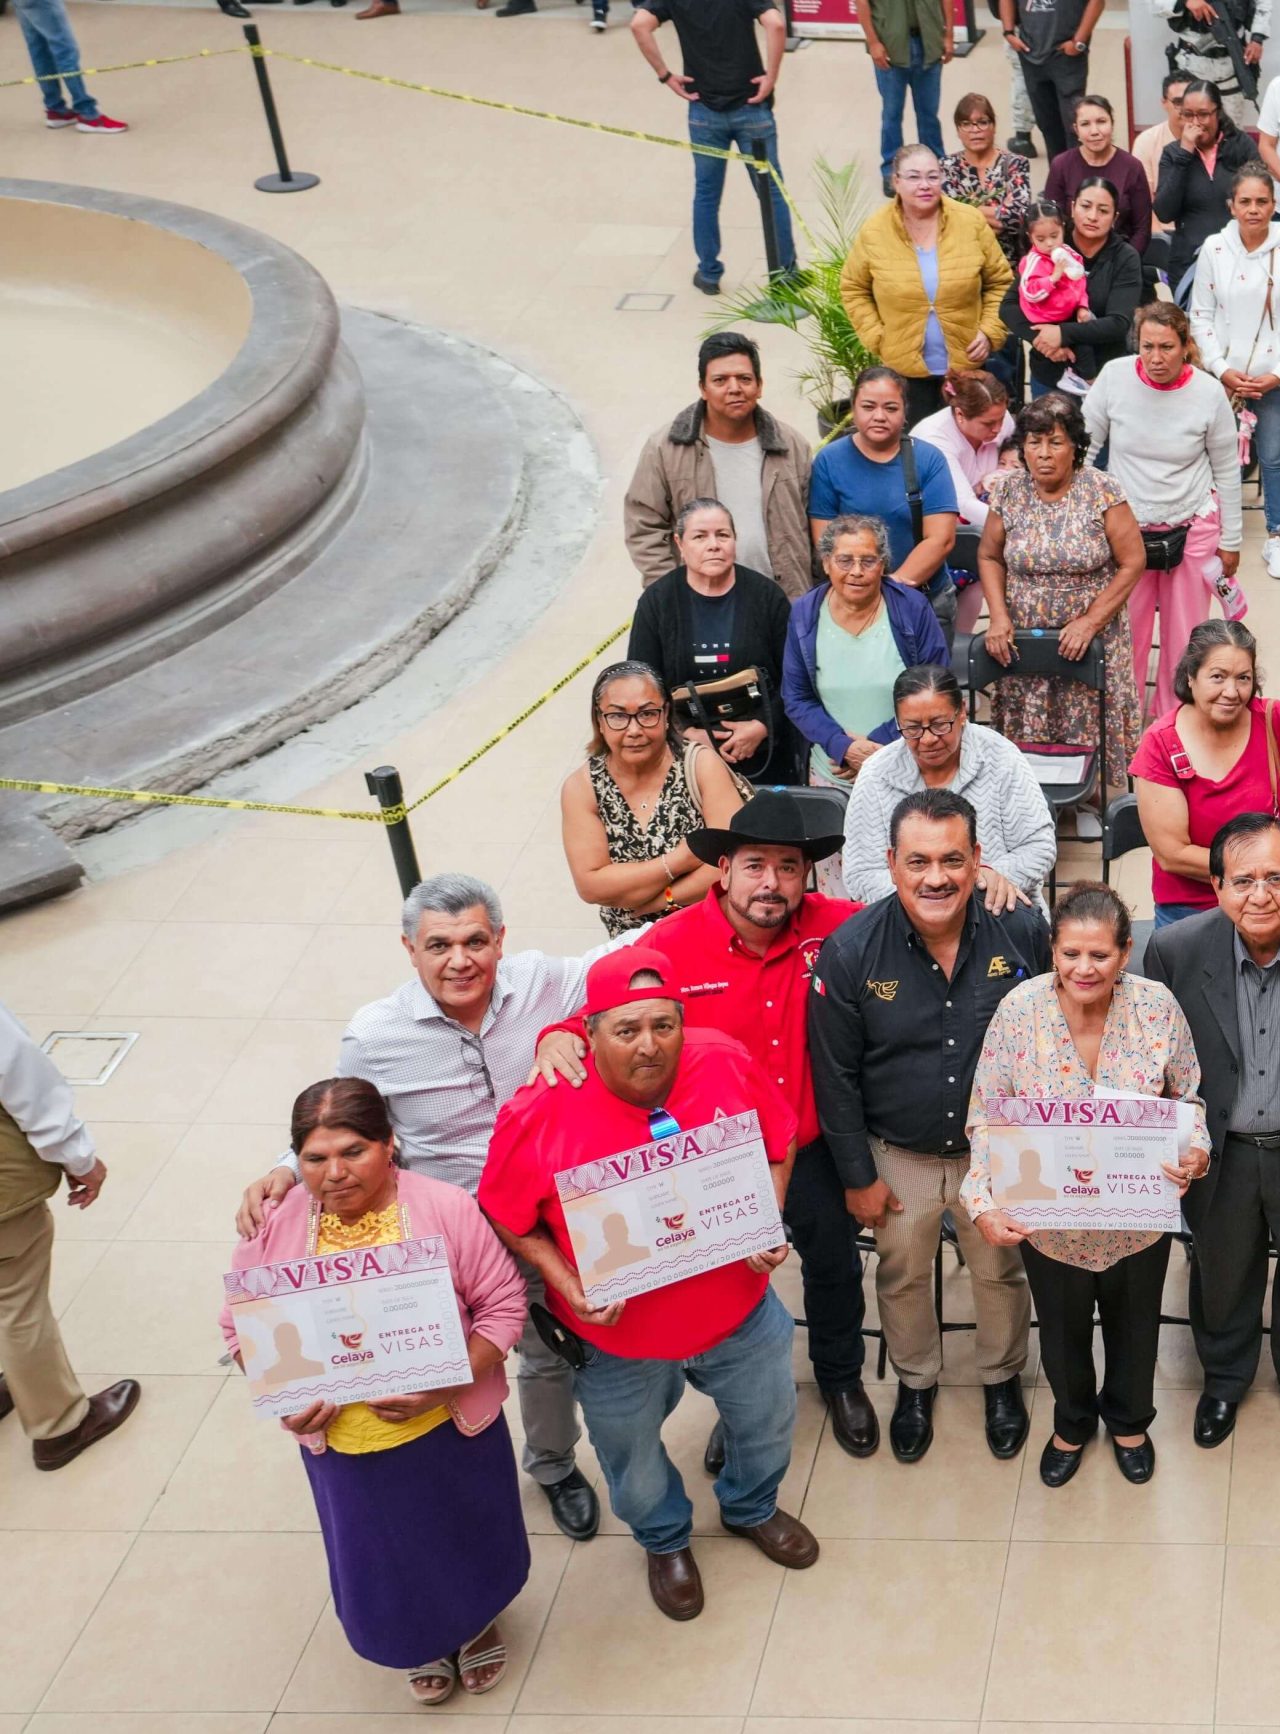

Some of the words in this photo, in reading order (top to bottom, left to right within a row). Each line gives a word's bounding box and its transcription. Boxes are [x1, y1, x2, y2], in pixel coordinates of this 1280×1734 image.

[1035, 1102, 1121, 1124] VISA
[609, 1135, 703, 1180] VISA
[1063, 1185, 1101, 1196] Celaya
[1107, 1183, 1162, 1195] VISAS
[699, 1199, 740, 1216] ENTREGA
[744, 1193, 756, 1202] DE
[701, 1203, 759, 1230] VISAS
[656, 1229, 695, 1247] Celaya
[282, 1252, 384, 1288] VISA
[378, 1326, 424, 1339] ENTREGA
[428, 1323, 441, 1332] DE
[380, 1333, 444, 1354] VISAS
[331, 1350, 374, 1366] Celaya
